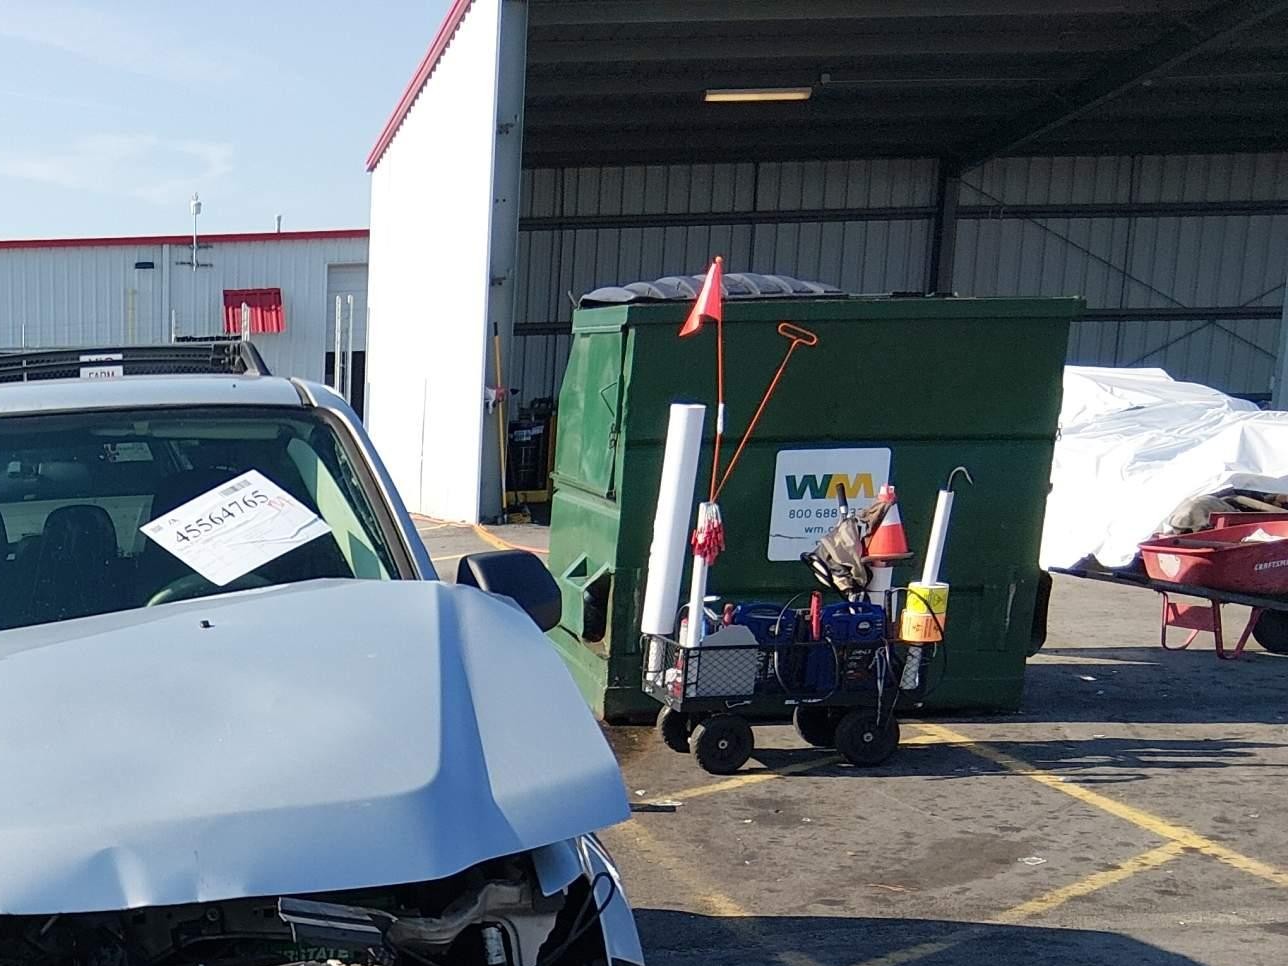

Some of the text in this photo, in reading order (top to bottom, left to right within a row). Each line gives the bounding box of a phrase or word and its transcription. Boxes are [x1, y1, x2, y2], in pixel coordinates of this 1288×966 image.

[785, 473, 874, 500] WM
[176, 489, 269, 543] 45564765
[789, 508, 812, 519] 800
[816, 508, 838, 518] 688
[804, 525, 834, 534] wm.c
